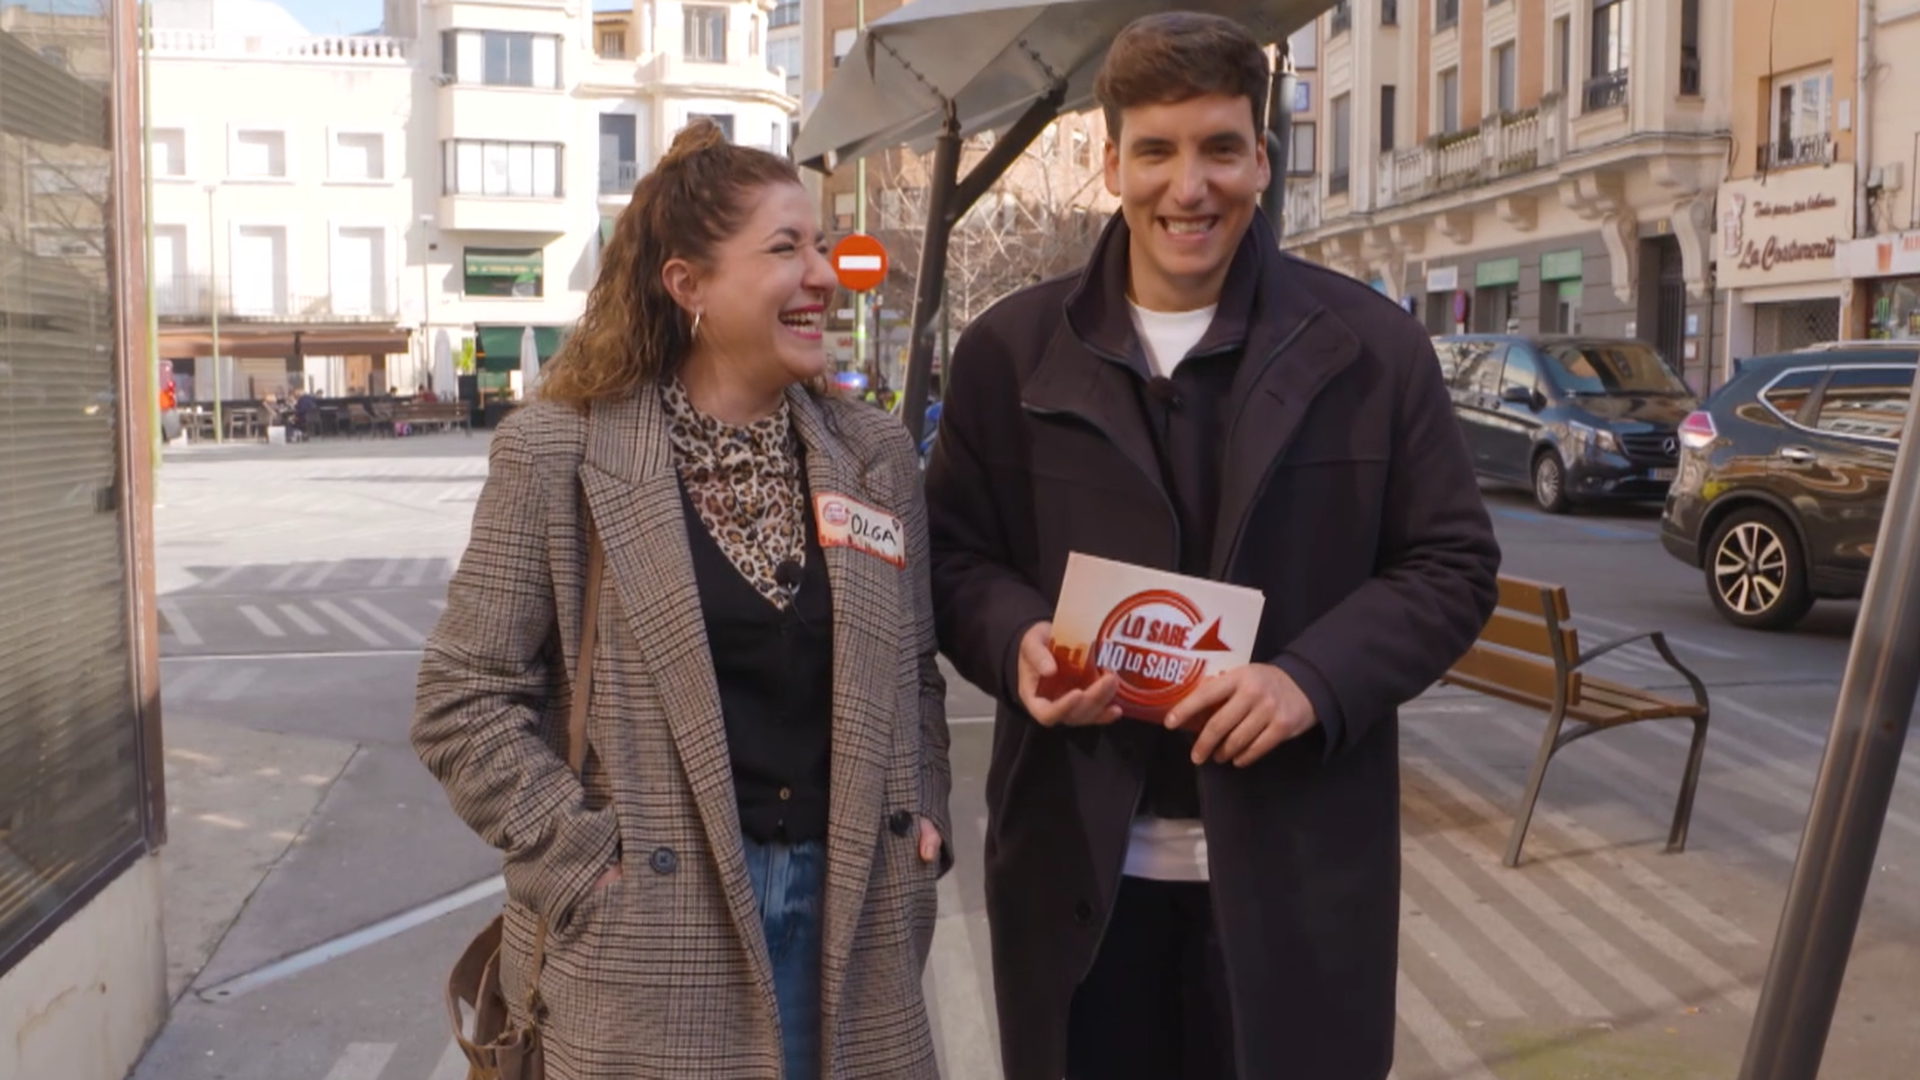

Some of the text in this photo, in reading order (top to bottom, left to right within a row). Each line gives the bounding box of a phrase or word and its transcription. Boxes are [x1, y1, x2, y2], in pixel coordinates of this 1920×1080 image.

[1738, 234, 1836, 271] La Costurerit
[851, 513, 897, 547] OLGA
[1121, 613, 1192, 650] LO SABE
[1096, 641, 1189, 685] NO LO SABE
